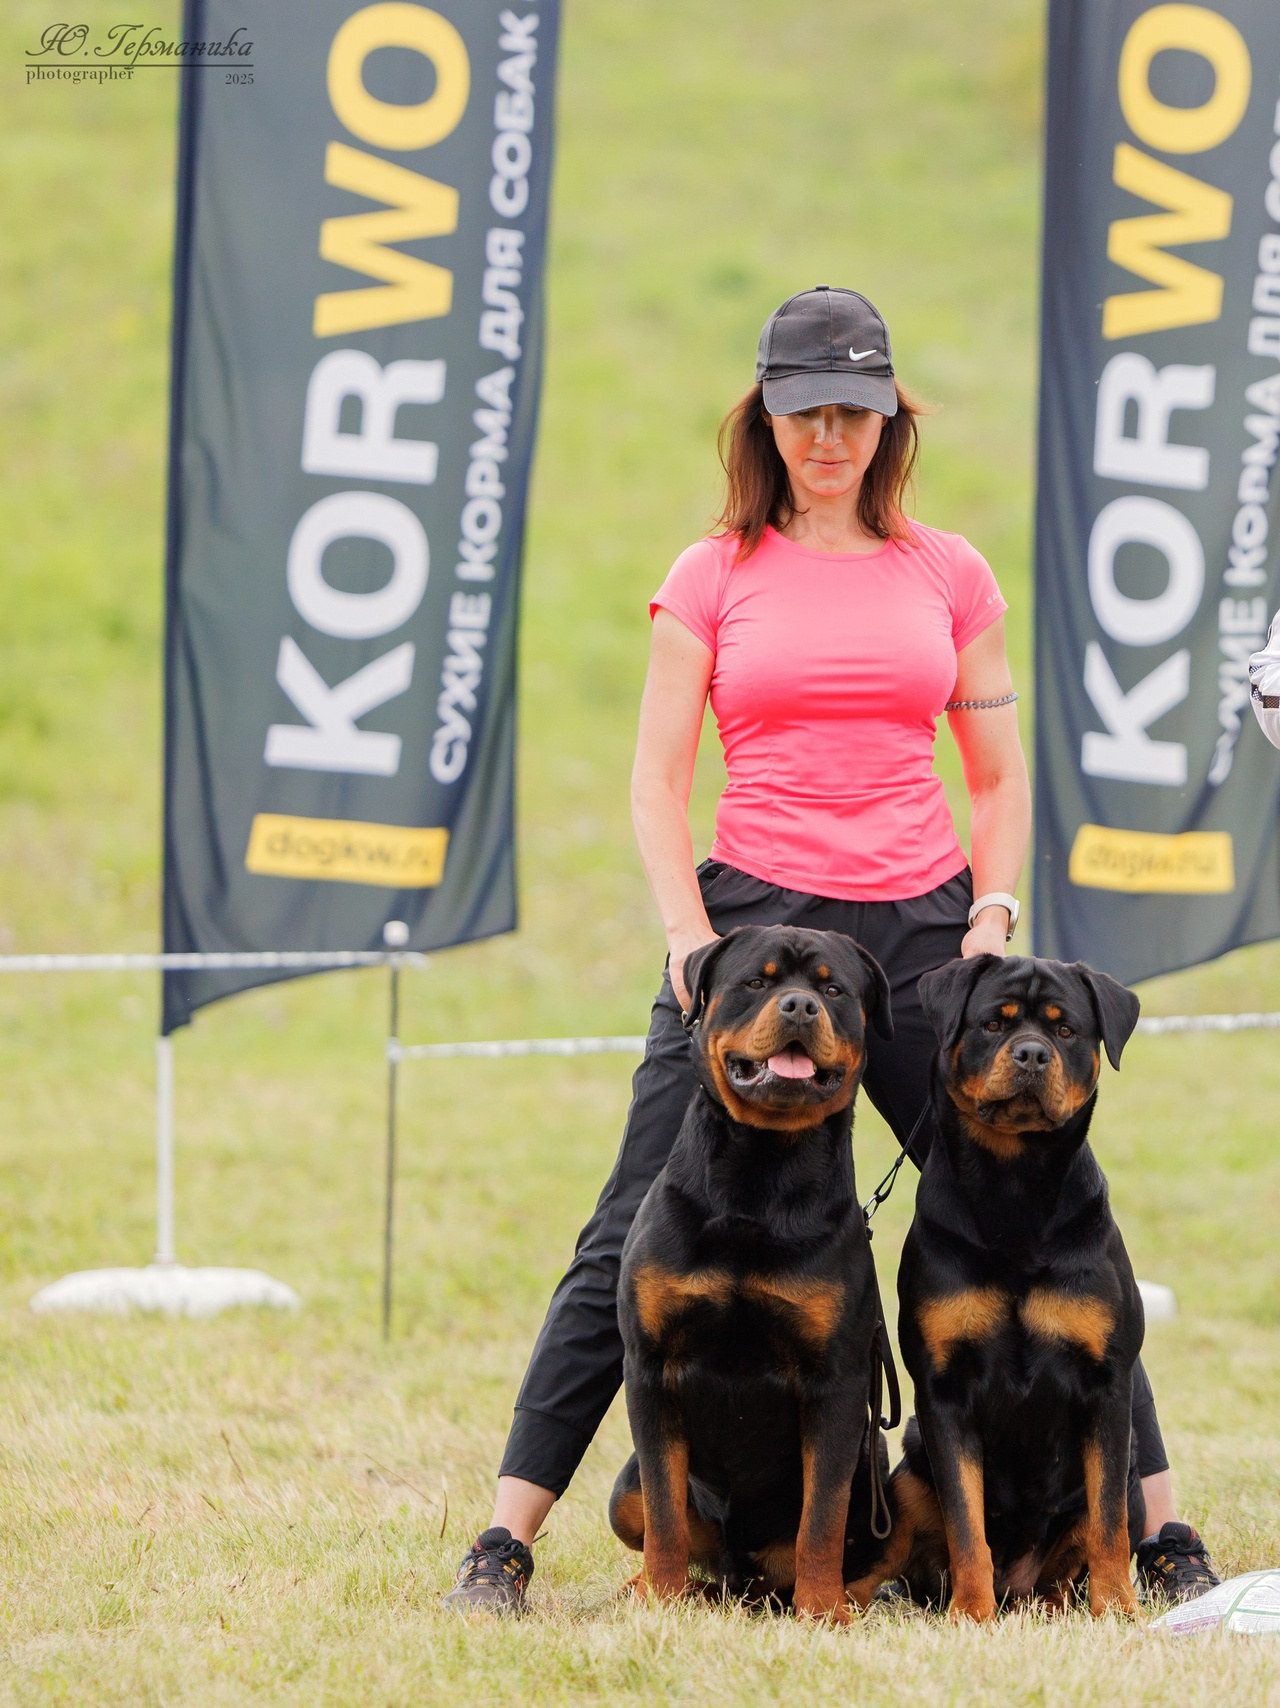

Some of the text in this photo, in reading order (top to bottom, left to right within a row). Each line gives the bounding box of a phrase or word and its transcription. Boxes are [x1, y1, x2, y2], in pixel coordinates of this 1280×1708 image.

[430, 9, 540, 784] СУХИЕ КОРМА ДЛЯ СОБАК
